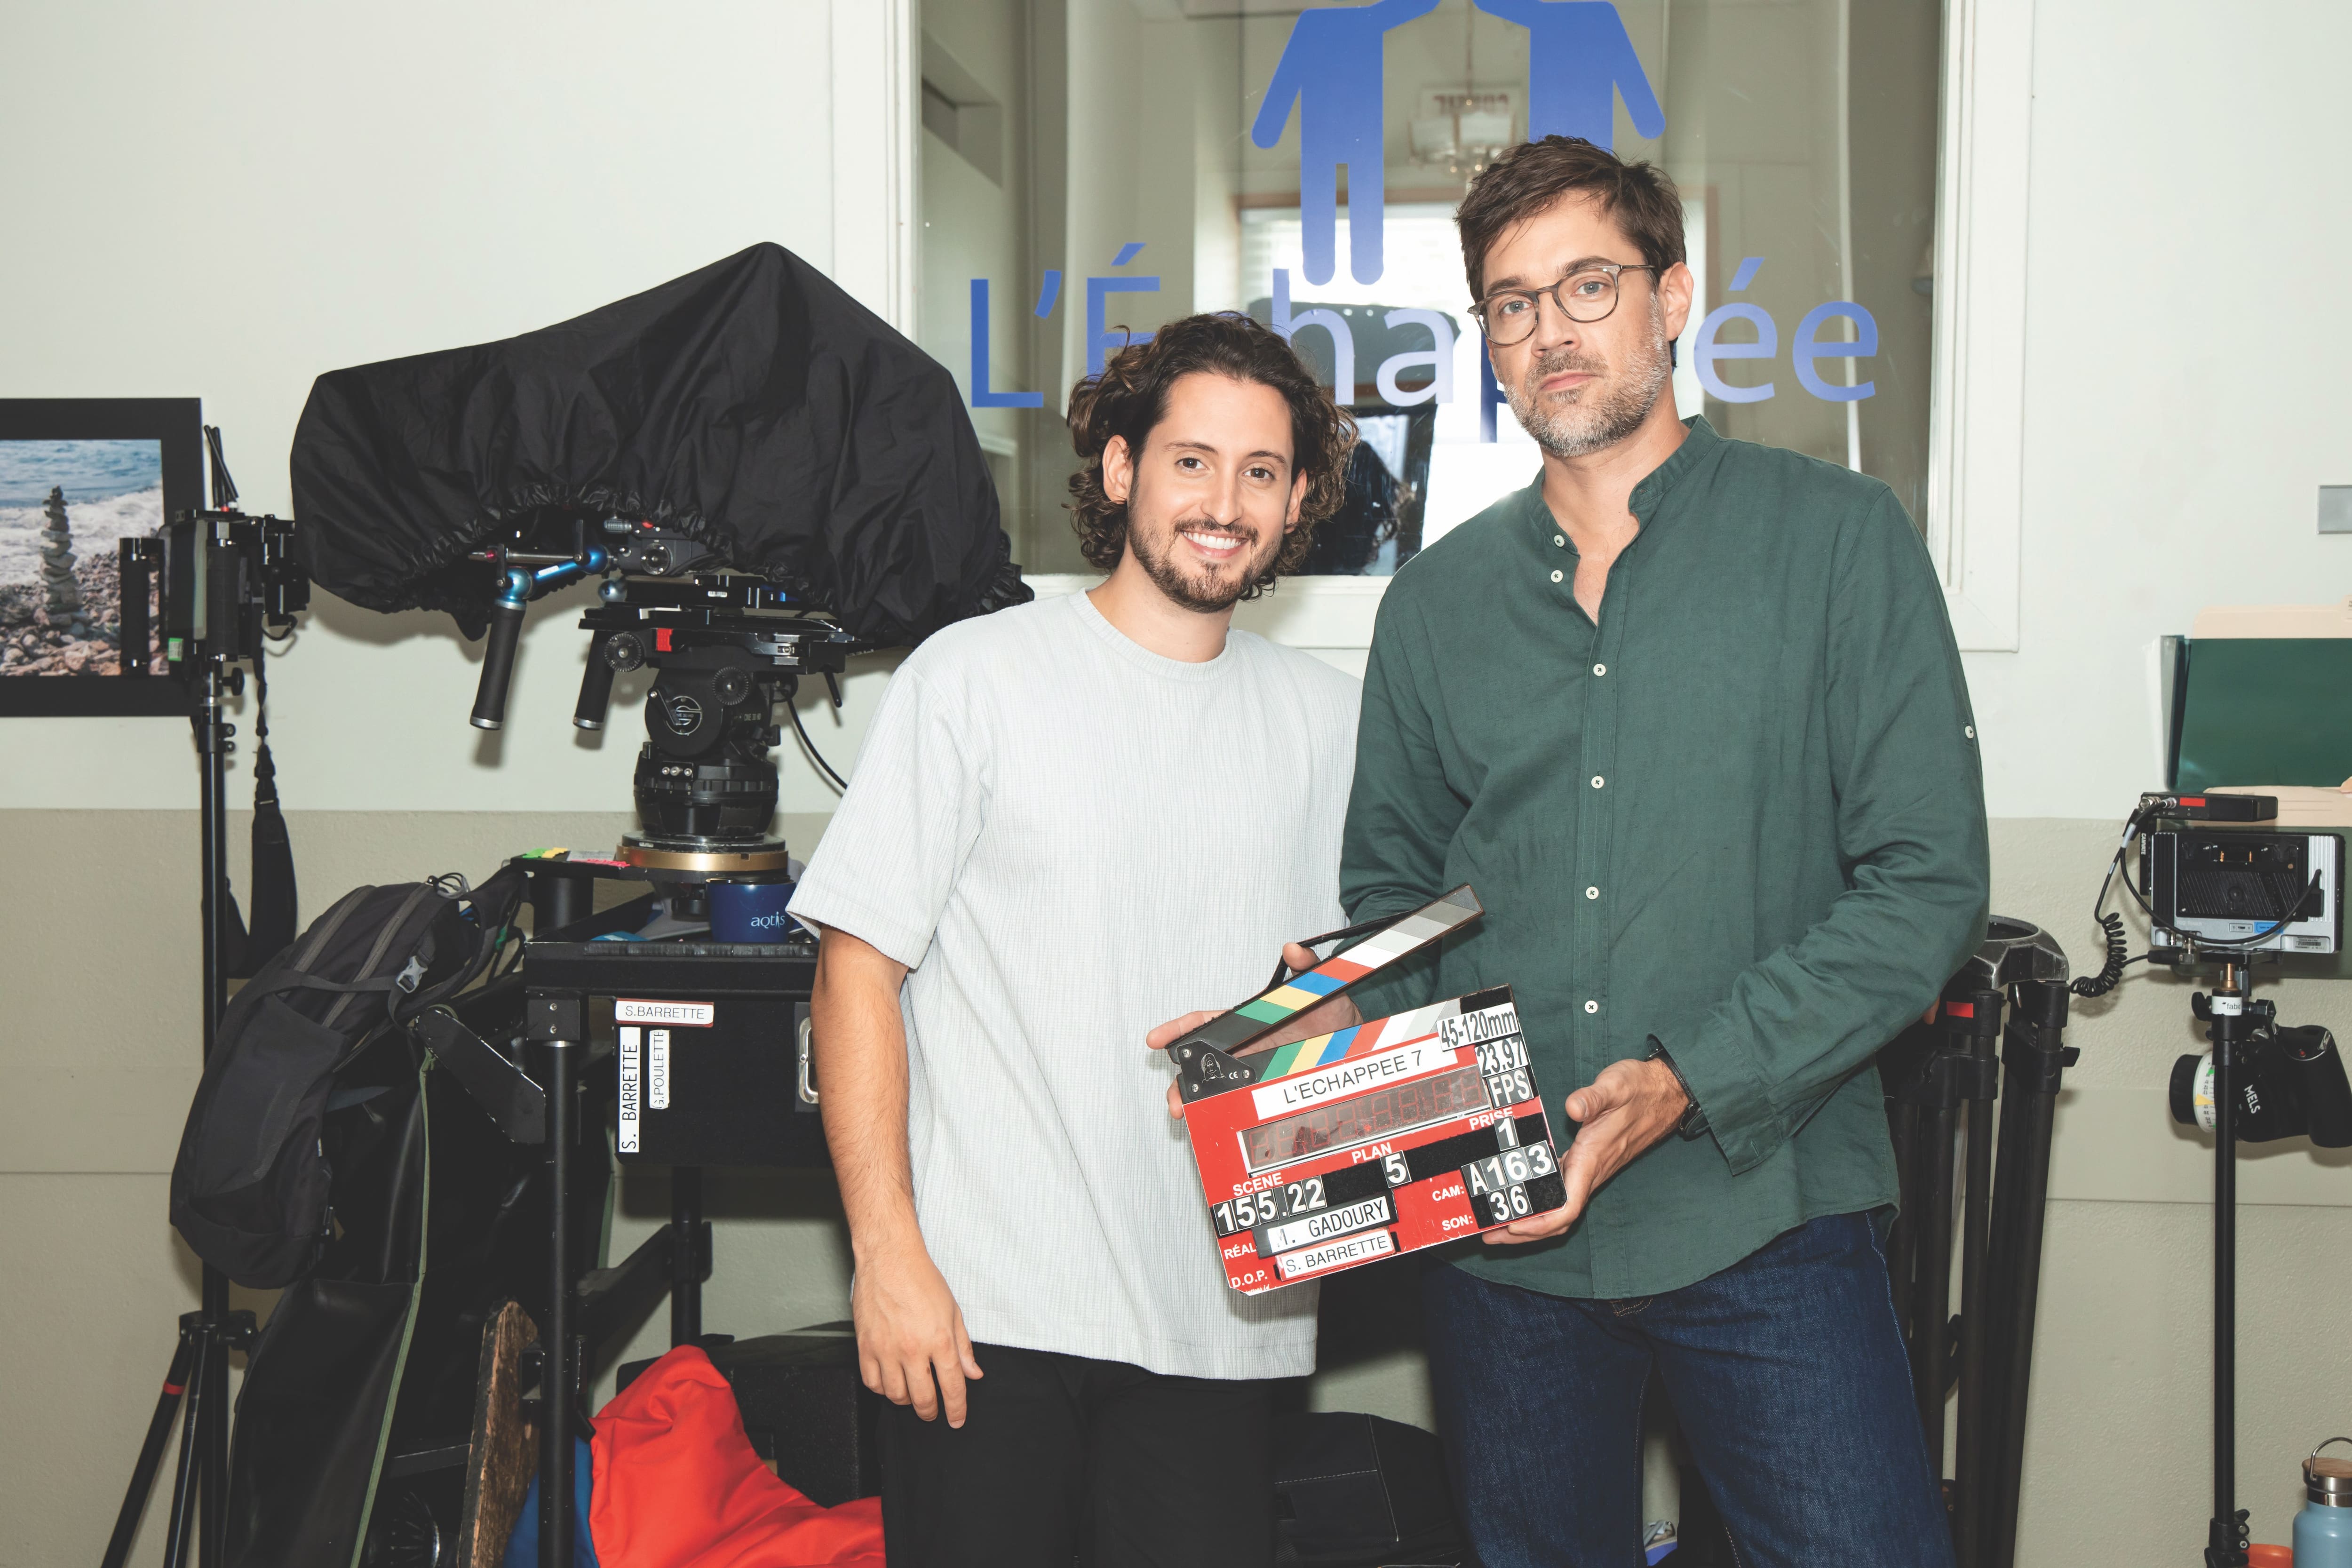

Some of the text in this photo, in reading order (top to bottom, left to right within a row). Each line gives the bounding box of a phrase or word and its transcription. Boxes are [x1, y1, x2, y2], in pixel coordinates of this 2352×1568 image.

[626, 1005, 704, 1019] S.BARRETTE
[1441, 1011, 1518, 1048] 45-120mm
[1476, 1035, 1523, 1076] 23.97
[1284, 1050, 1422, 1104] L'ECHAPPEE 7
[1488, 1069, 1530, 1107] FPS
[621, 1044, 637, 1149] S. BARRETTE
[2244, 1084, 2261, 1114] MELS
[1498, 1117, 1516, 1147] 1
[1351, 1142, 1392, 1163] PLAN
[1384, 1152, 1406, 1184] 5
[1232, 1173, 1284, 1196] SCENE
[1432, 1185, 1464, 1202] CAM:
[1309, 1200, 1385, 1237] GADOURY
[1441, 1185, 1528, 1231] SON: 36
[1231, 1269, 1268, 1289] D.O.P.
[1286, 1259, 1302, 1273] S.
[1305, 1235, 1388, 1268] BARRETTE
